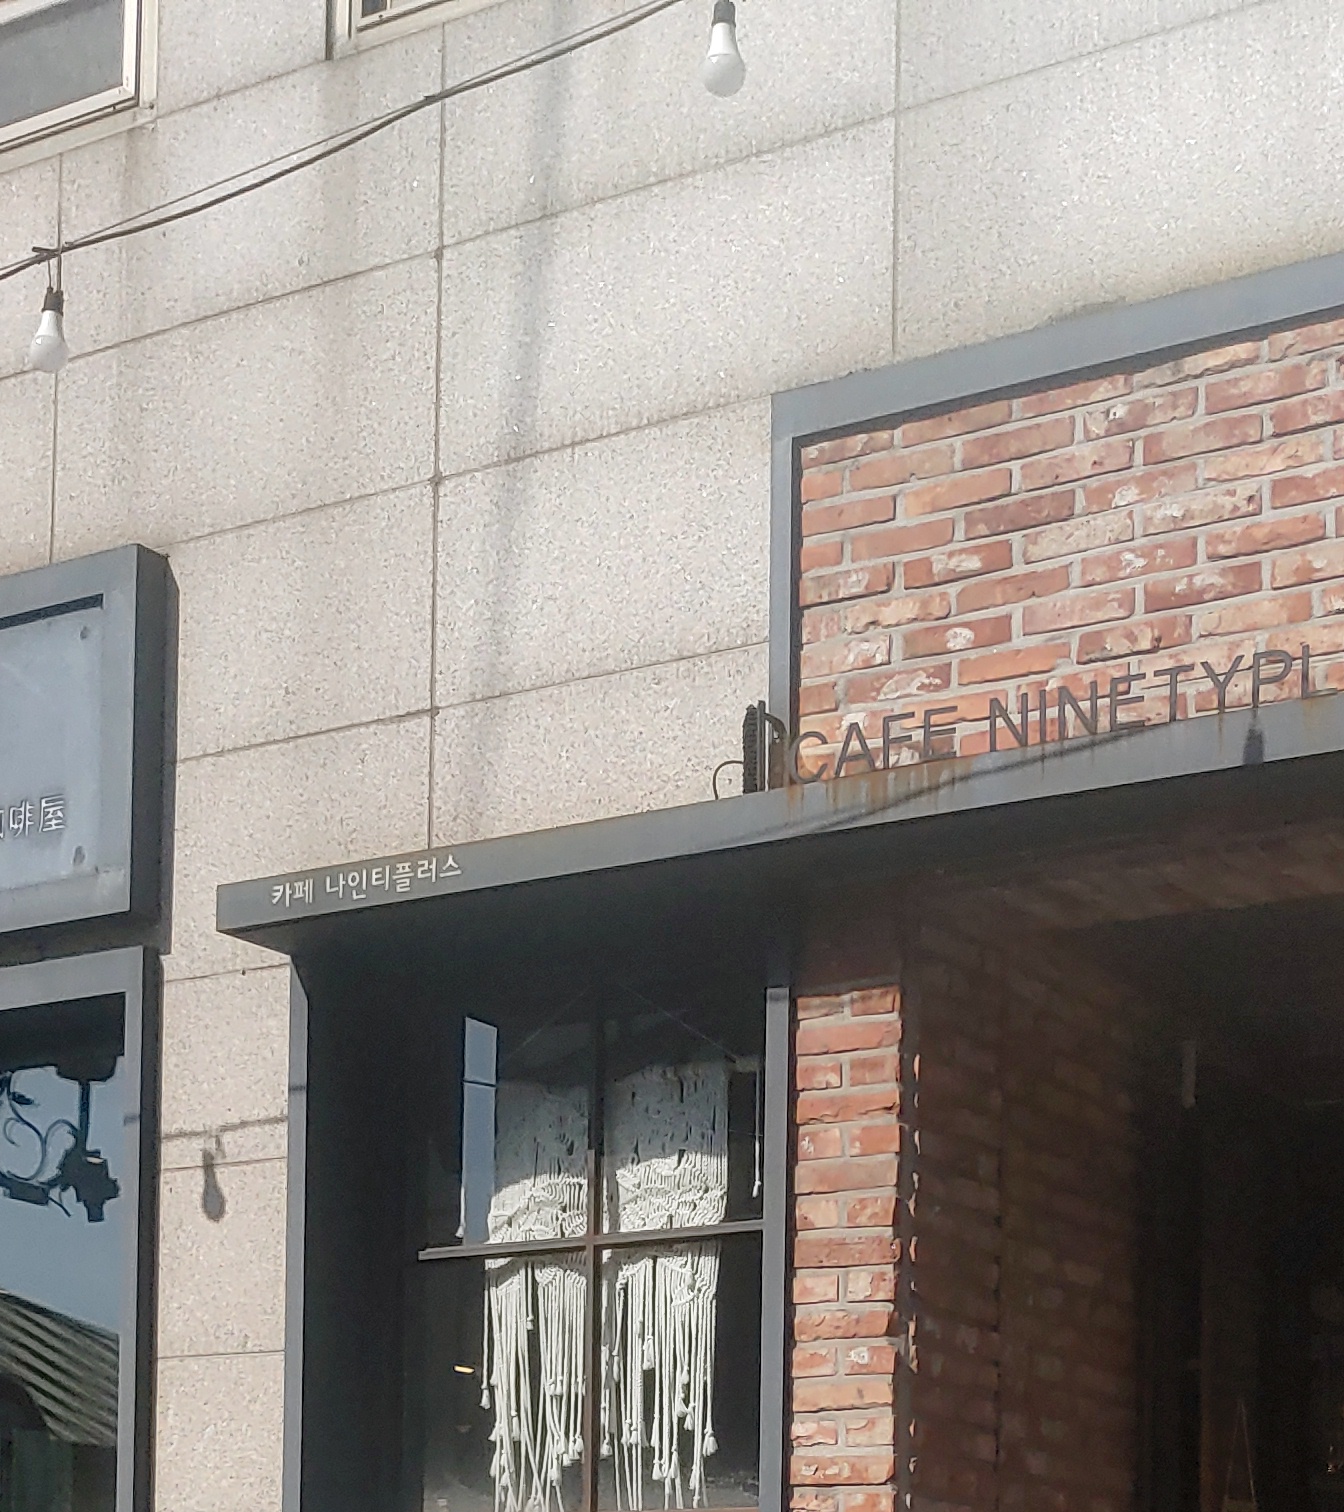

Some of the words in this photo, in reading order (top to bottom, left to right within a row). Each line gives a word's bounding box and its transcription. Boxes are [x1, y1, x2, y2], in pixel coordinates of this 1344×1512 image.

[789, 705, 958, 785] CAFE
[271, 879, 314, 908] 카페
[325, 854, 462, 901] 나인티플러스
